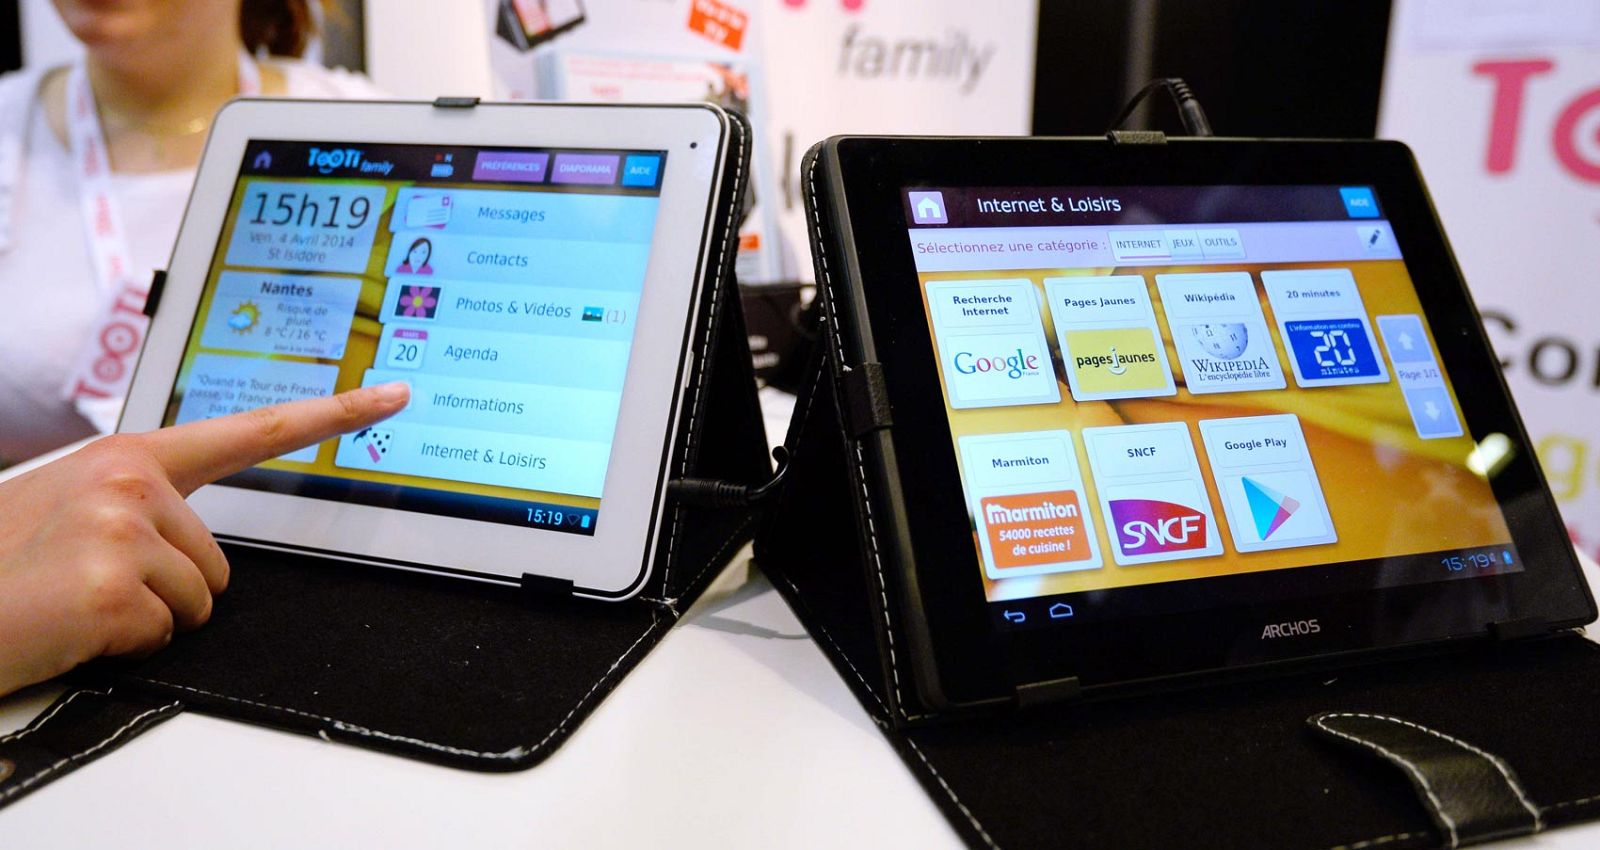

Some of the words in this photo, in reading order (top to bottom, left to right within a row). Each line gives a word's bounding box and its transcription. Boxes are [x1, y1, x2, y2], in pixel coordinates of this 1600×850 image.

[838, 24, 995, 96] family
[361, 160, 394, 176] family
[560, 163, 610, 174] DIAPORAMA
[630, 165, 650, 175] AIDE
[250, 192, 370, 229] 15h19
[977, 198, 1046, 214] Internet
[1051, 198, 1065, 213] &
[1068, 196, 1121, 212] Loisirs
[477, 207, 546, 223] Messages
[280, 233, 288, 243] 4
[293, 234, 319, 245] Avril
[321, 235, 355, 247] 2014
[917, 241, 1004, 255] Sélectionnez
[1008, 243, 1033, 253] une
[1037, 239, 1098, 254] catégorie
[1115, 240, 1161, 250] INTERNET
[1171, 239, 1194, 249] JEUX
[1204, 237, 1238, 247] OUTILS
[268, 248, 281, 259] St
[466, 251, 528, 268] Contacts
[260, 281, 313, 297] Nantes
[1287, 290, 1299, 299] 20
[1302, 289, 1342, 299] minutes
[953, 294, 1013, 304] Recherche
[1064, 298, 1097, 309] Pages
[1100, 297, 1136, 308] Jaunes
[1184, 291, 1236, 303] Wikipédia
[277, 302, 311, 316] Risque
[314, 305, 327, 316] de
[455, 297, 503, 313] Photos
[508, 300, 519, 313] &
[524, 302, 572, 318] Vidéos
[606, 310, 627, 325] (1)
[962, 306, 1009, 317] Internet
[285, 317, 312, 328] pluie
[297, 329, 310, 339] 16
[394, 343, 418, 362] 20
[443, 345, 499, 361] Agenda
[1309, 329, 1357, 367] 20
[954, 348, 1039, 380] Google
[1320, 366, 1360, 376] minutes
[1198, 371, 1253, 382] L'encyclopédie
[1253, 369, 1271, 379] libre
[1399, 369, 1421, 381] Page
[250, 379, 271, 391] Tour
[274, 381, 288, 392] de
[290, 383, 327, 397] France
[432, 393, 525, 415] Informations
[1224, 440, 1262, 451] Google
[1264, 437, 1288, 449] Play
[420, 442, 479, 462] Internet
[483, 449, 494, 464] &
[499, 451, 547, 470] Loisirs
[1127, 447, 1157, 458] SNCF
[991, 455, 1050, 468] Marmiton
[527, 508, 563, 526] 15:19
[985, 502, 1078, 525] marmiton
[999, 527, 1031, 541] 54000
[1032, 524, 1075, 537] recettes
[1120, 515, 1201, 549] SNCF
[1012, 545, 1026, 556] de
[1027, 541, 1066, 555] cuisine
[1441, 553, 1490, 573] 15:19
[1260, 619, 1321, 640] ARCHOS
